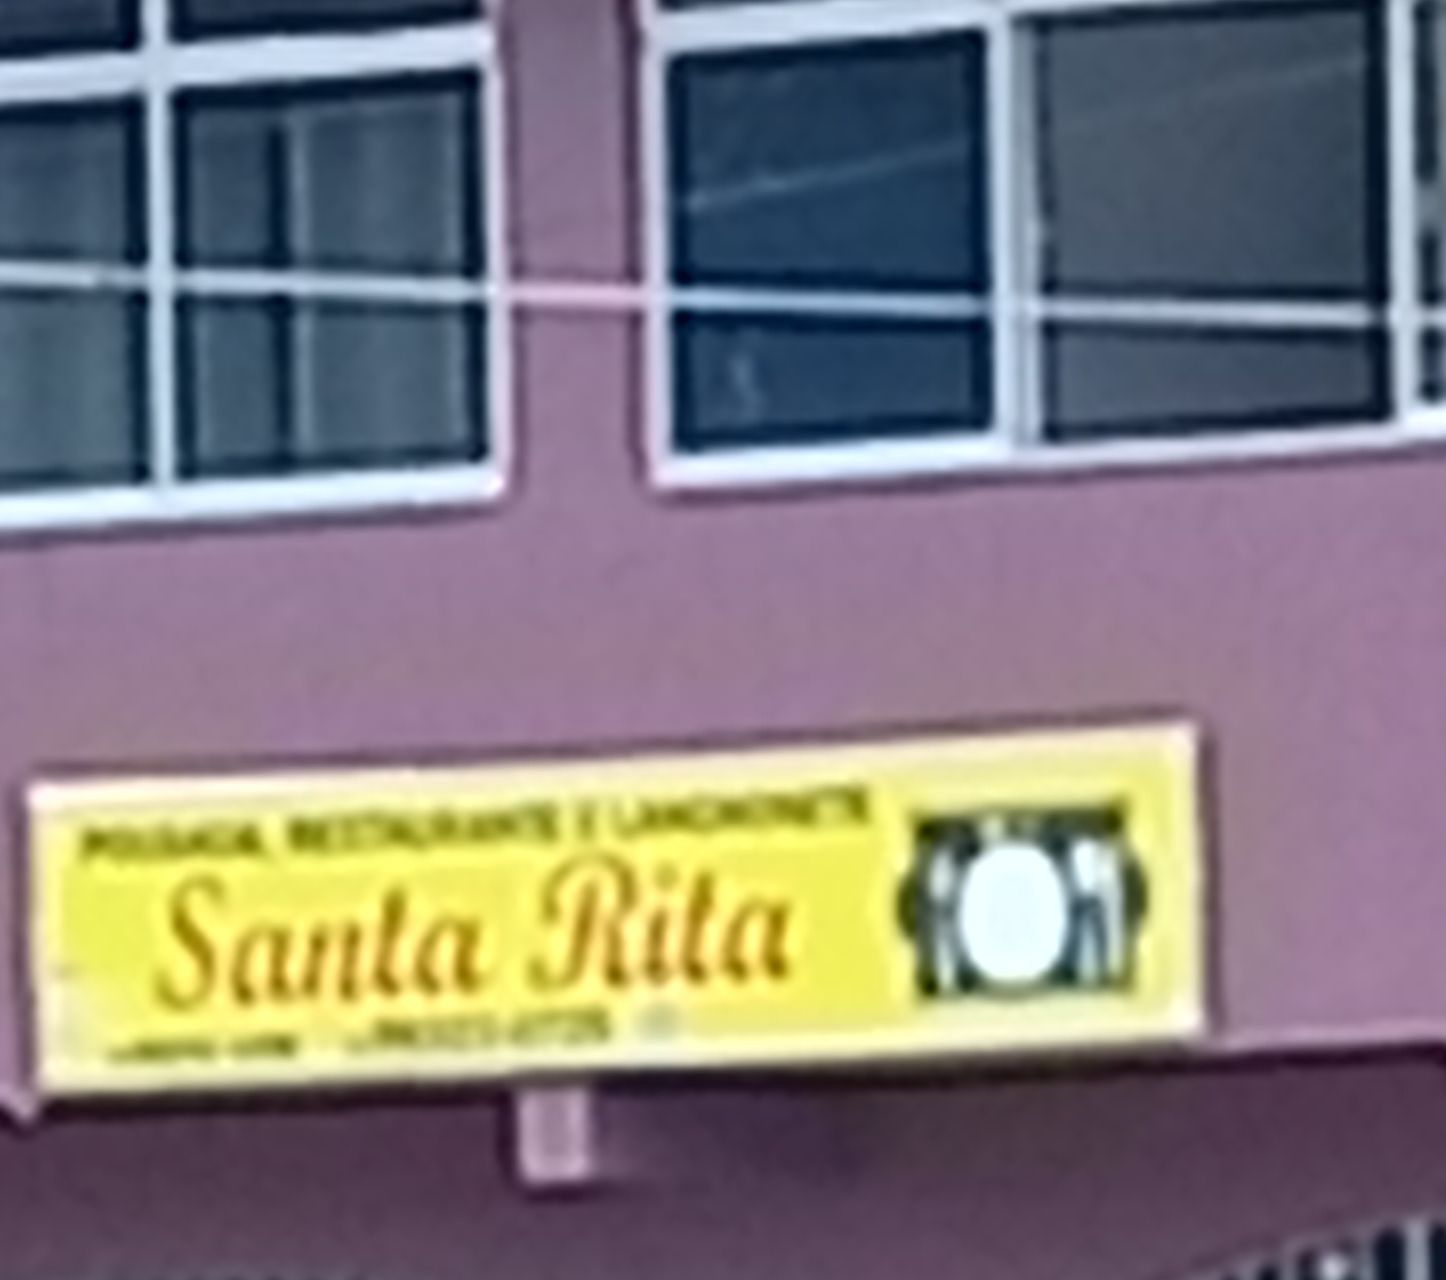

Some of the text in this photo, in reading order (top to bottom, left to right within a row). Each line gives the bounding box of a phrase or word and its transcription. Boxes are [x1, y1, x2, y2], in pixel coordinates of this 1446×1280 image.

[287, 800, 558, 854] RESTAURANTE
[612, 784, 870, 841] LANCHONETE
[153, 851, 792, 1012] Santa Rita
